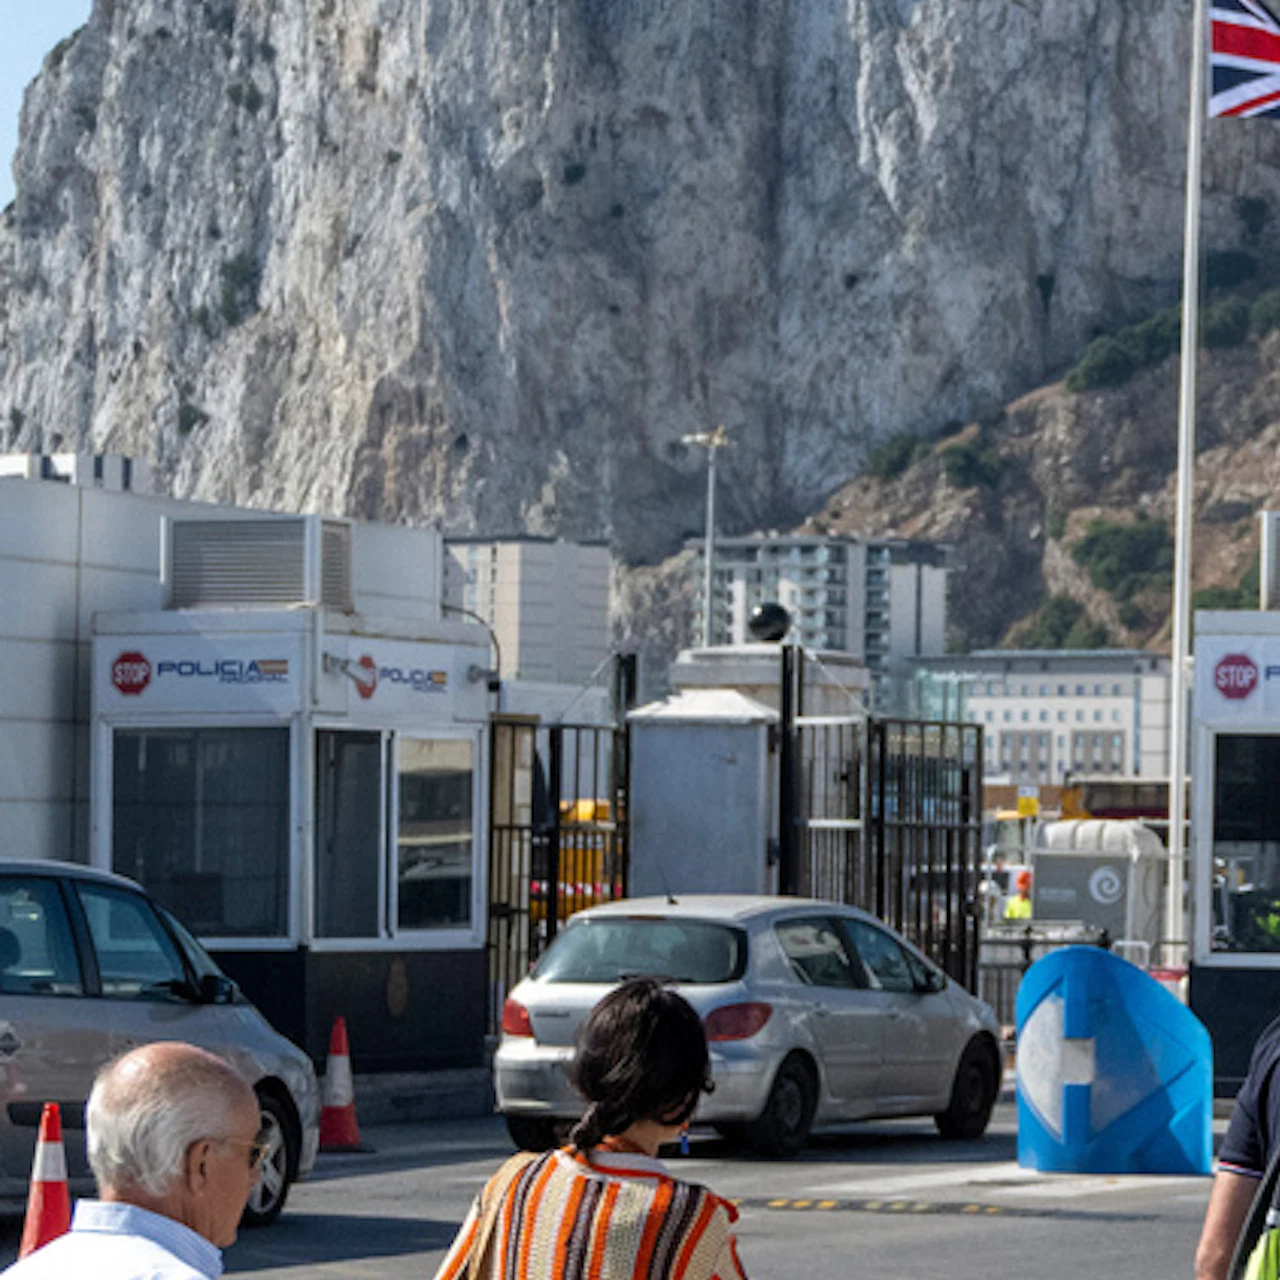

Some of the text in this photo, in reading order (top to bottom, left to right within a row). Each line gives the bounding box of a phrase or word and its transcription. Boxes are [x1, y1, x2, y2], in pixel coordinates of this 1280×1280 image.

[114, 659, 259, 684] STOP POLICIA
[1216, 664, 1254, 689] STOP
